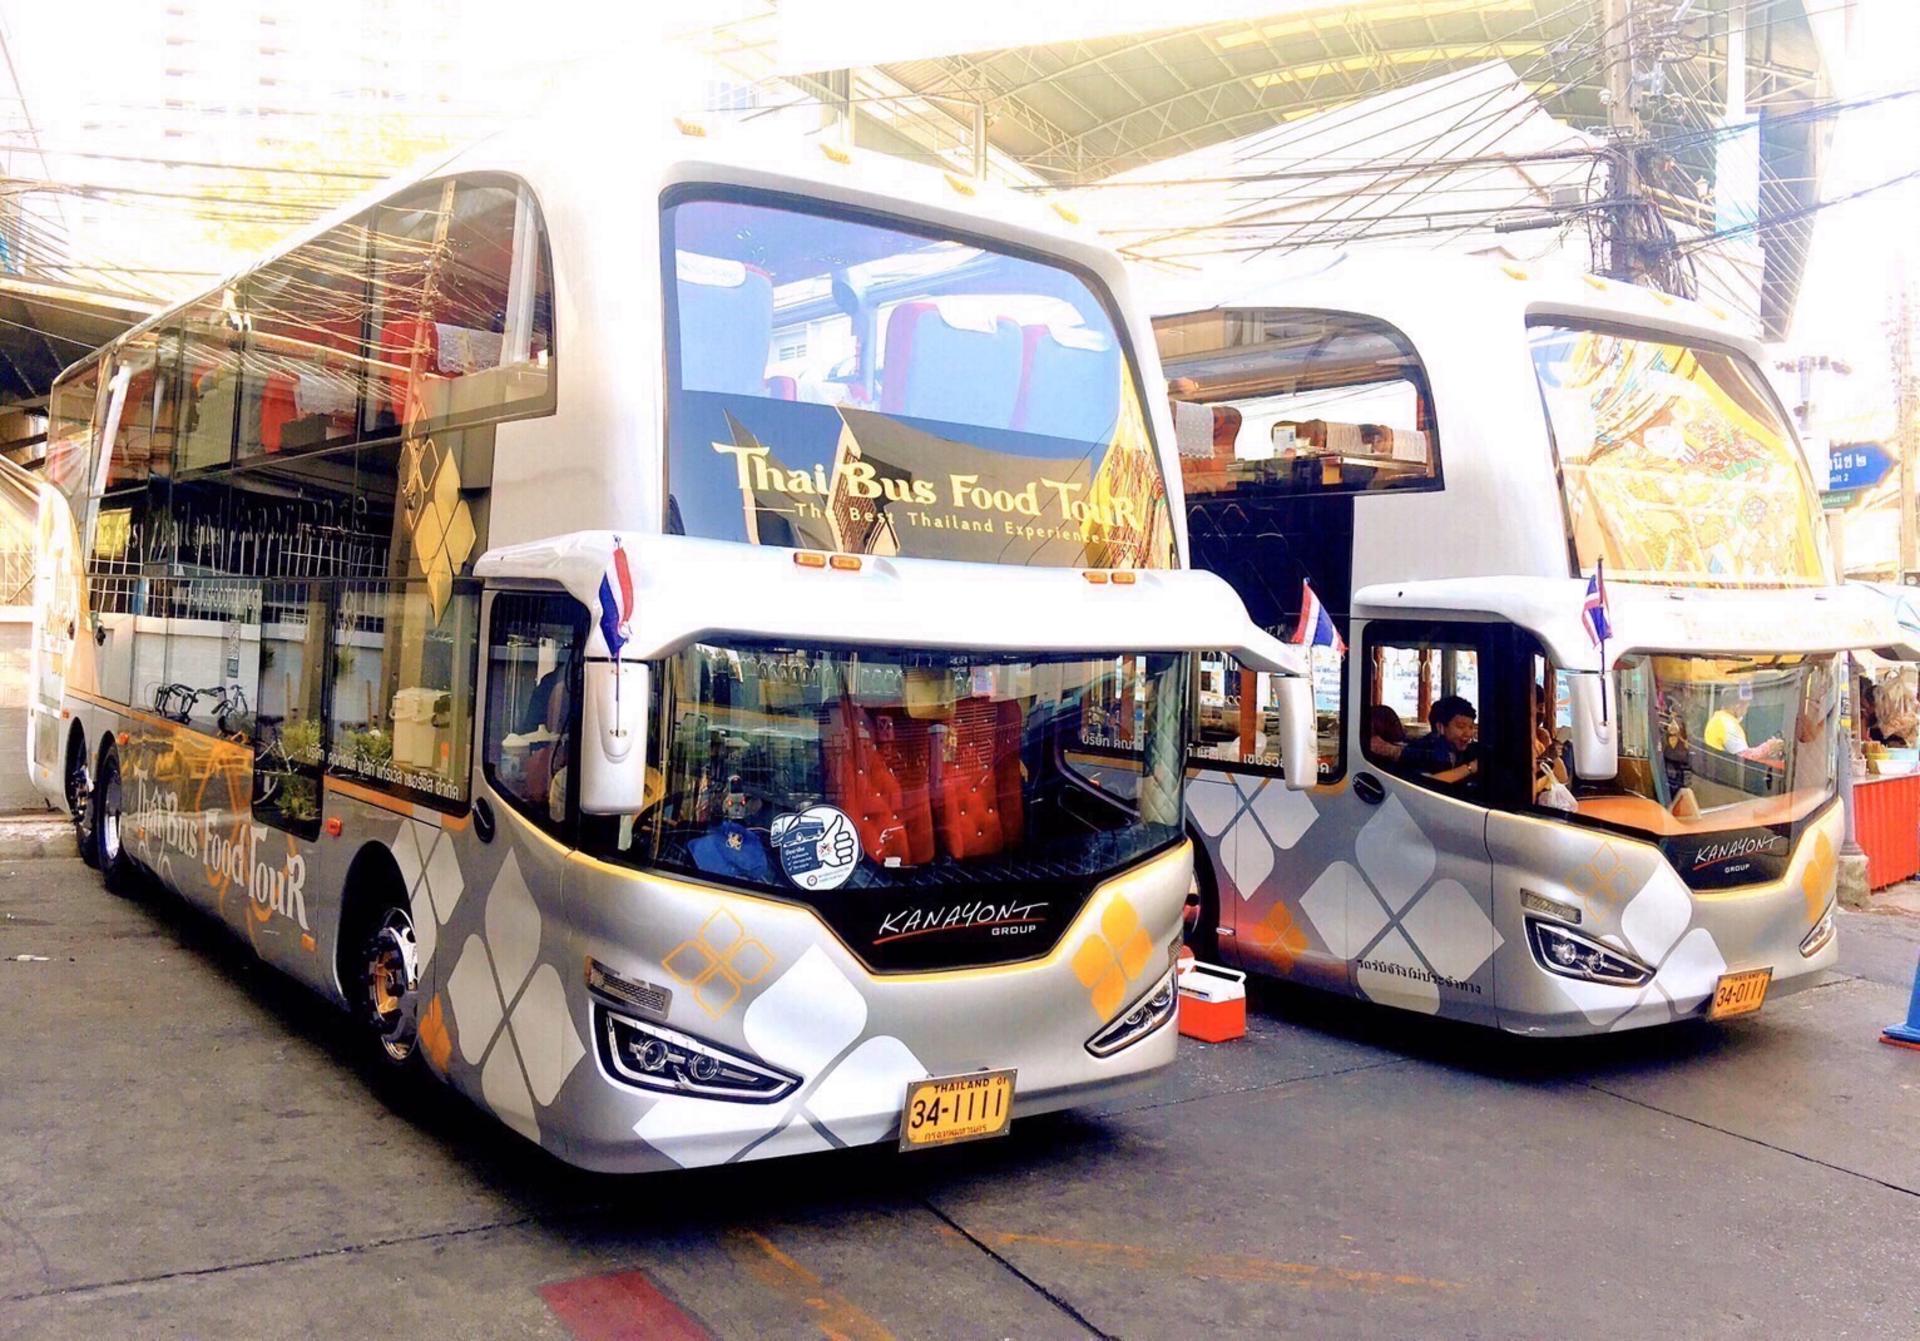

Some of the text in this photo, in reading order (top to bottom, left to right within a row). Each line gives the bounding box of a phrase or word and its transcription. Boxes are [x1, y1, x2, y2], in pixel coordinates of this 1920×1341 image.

[711, 441, 830, 496] Thai
[839, 461, 937, 505] Bus
[949, 474, 1041, 516] Food
[849, 507, 895, 527] Best
[907, 511, 994, 533] Thailand
[1005, 521, 1101, 545] Experience
[165, 791, 198, 858] Bus
[203, 807, 247, 887] Food
[1694, 835, 1782, 863] KANAYONT
[1724, 863, 1750, 873] GROUP
[878, 900, 1049, 935] KANAYONT
[991, 924, 1036, 936] GROUP
[1716, 979, 1766, 1008] 34-0111
[934, 1078, 990, 1094] THAILAND
[911, 1088, 1002, 1129] 34-1111
